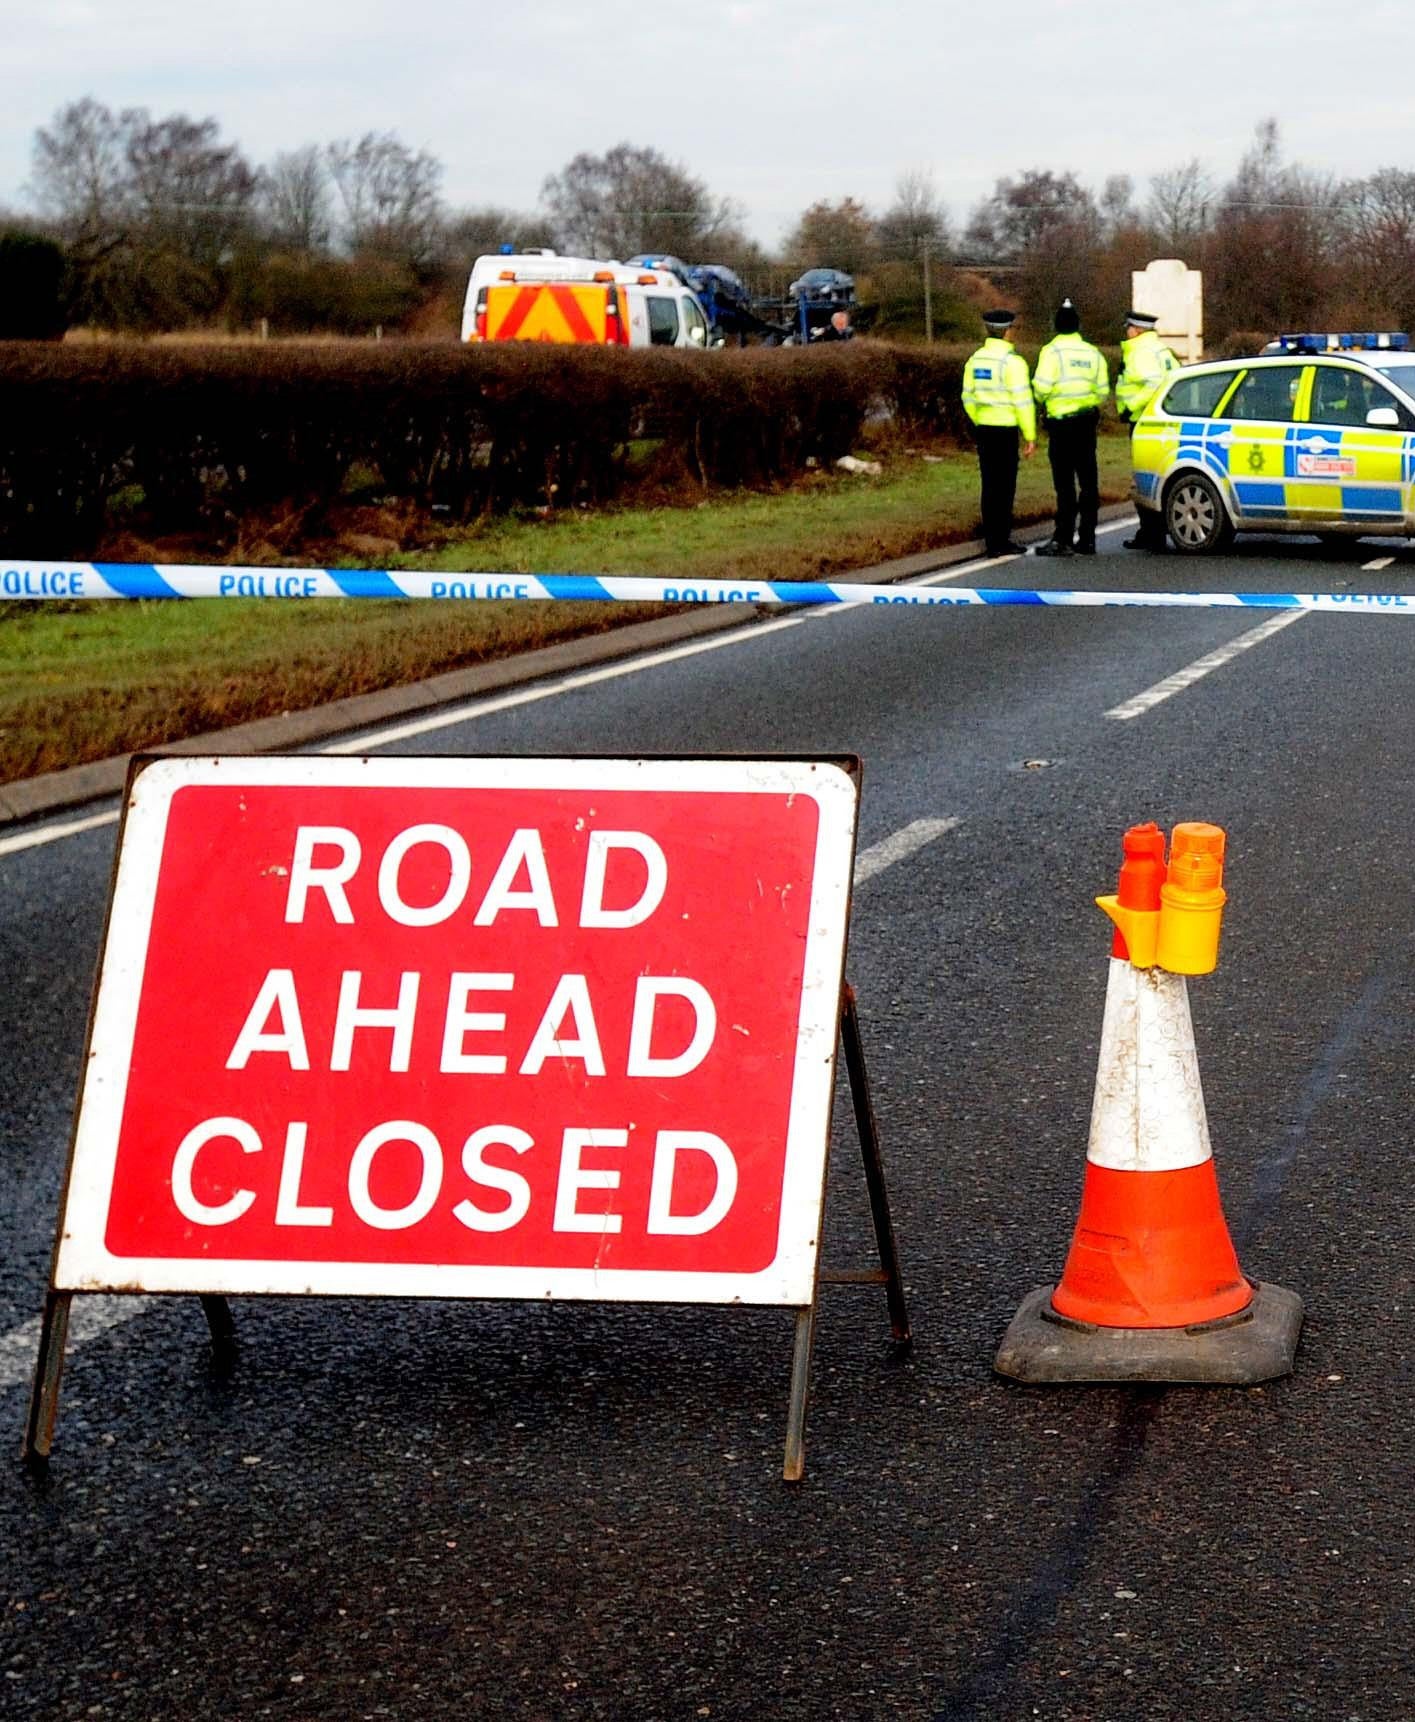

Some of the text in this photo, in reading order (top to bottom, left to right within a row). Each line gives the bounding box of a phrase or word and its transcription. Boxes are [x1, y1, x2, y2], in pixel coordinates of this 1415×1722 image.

[0, 570, 85, 597] OLICE
[219, 574, 318, 597] POLICE
[431, 581, 529, 599] POLICE
[284, 823, 668, 929] ROAD
[225, 968, 717, 1078] AHEAD
[171, 1116, 738, 1236] CLOSED
